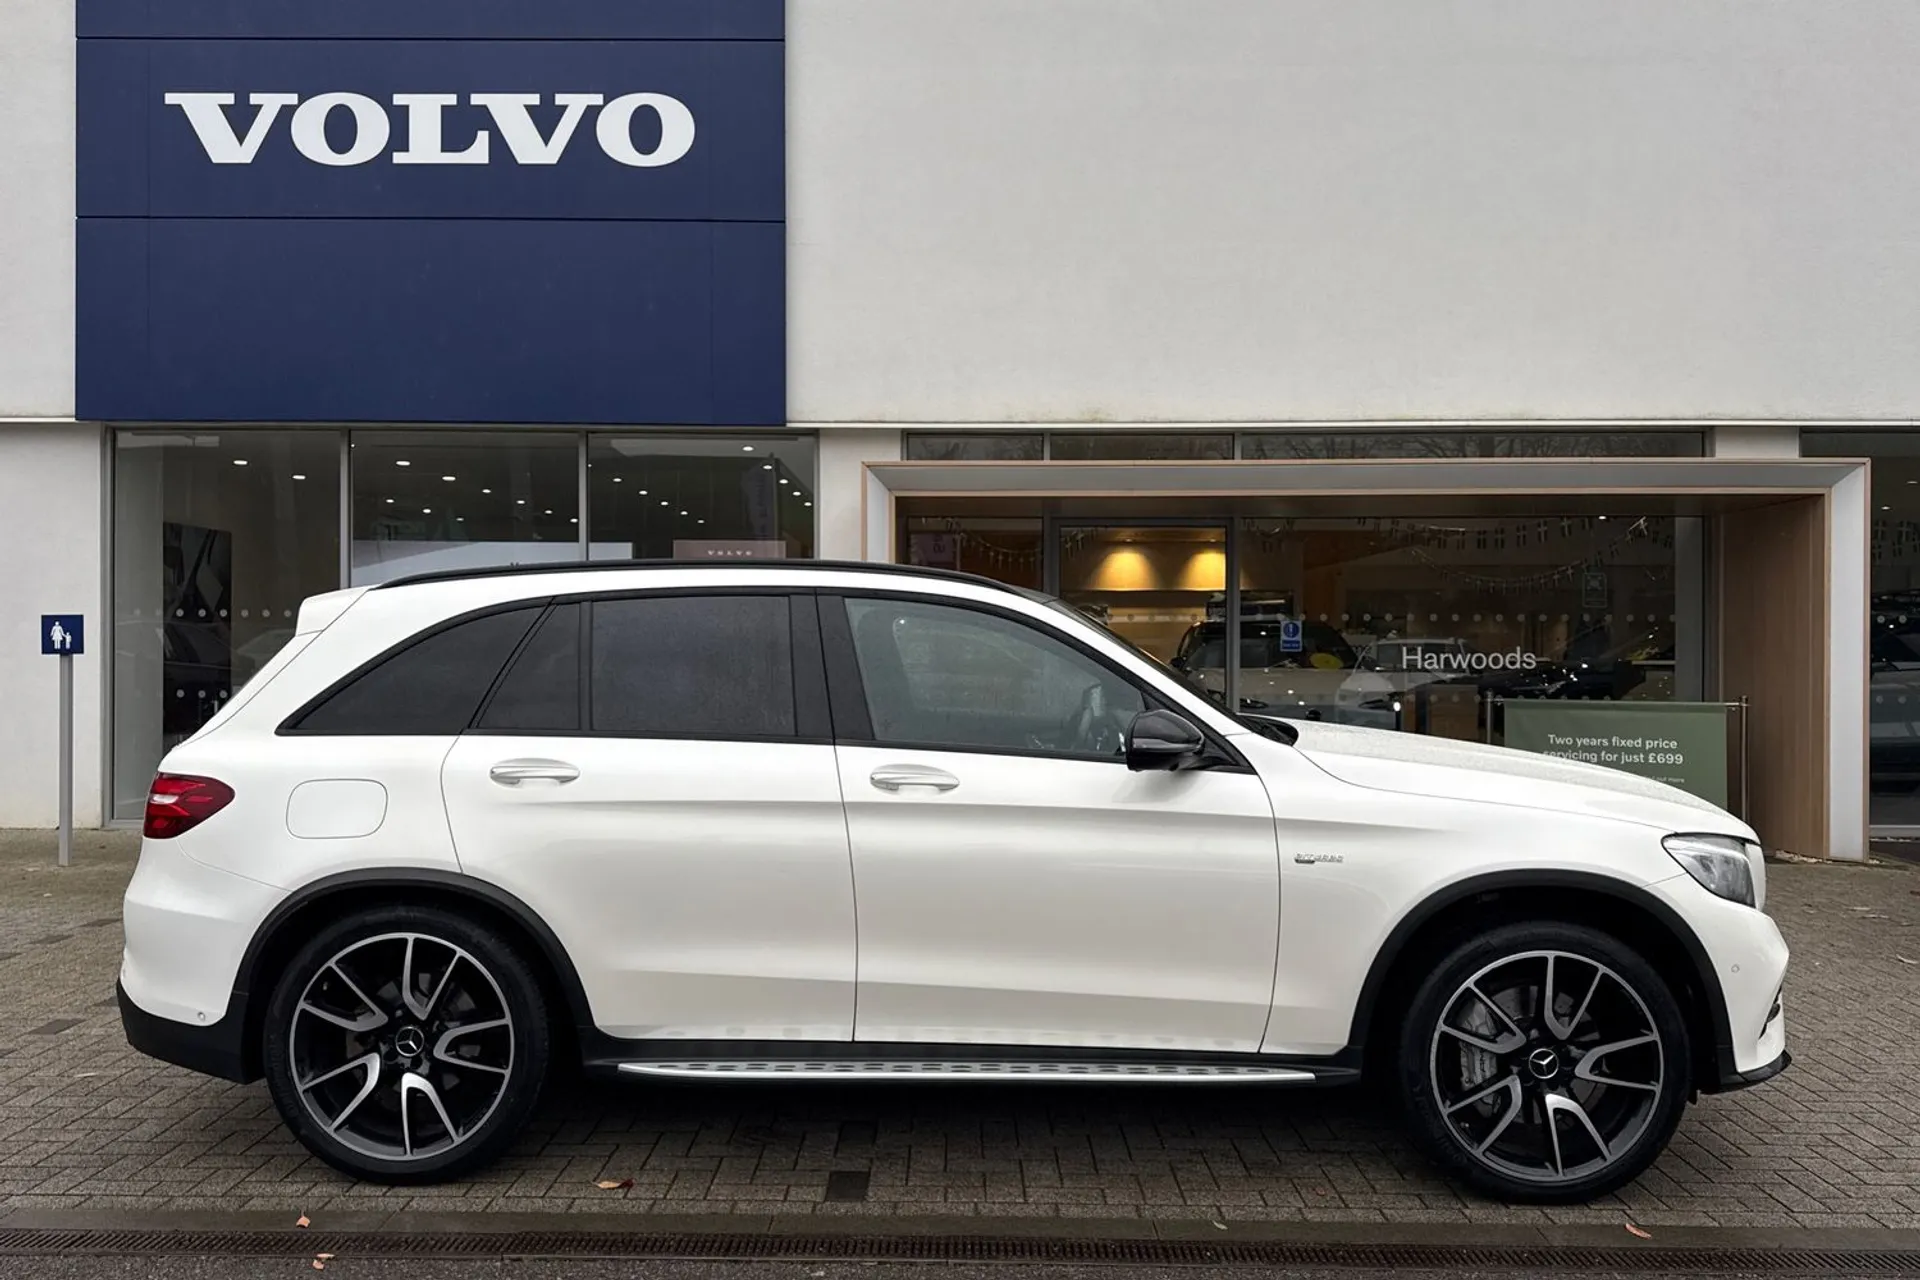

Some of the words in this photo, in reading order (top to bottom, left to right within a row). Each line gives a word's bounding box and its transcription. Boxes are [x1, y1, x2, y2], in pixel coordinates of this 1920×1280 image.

[164, 92, 696, 167] VOLVO
[1402, 645, 1537, 670] Harwoods
[1548, 734, 1574, 746] Two
[1576, 736, 1609, 747] years
[1611, 736, 1642, 748] fixed
[1645, 738, 1678, 750] price
[1600, 751, 1619, 762] for
[1621, 751, 1645, 764] just
[1648, 753, 1684, 764] £699
